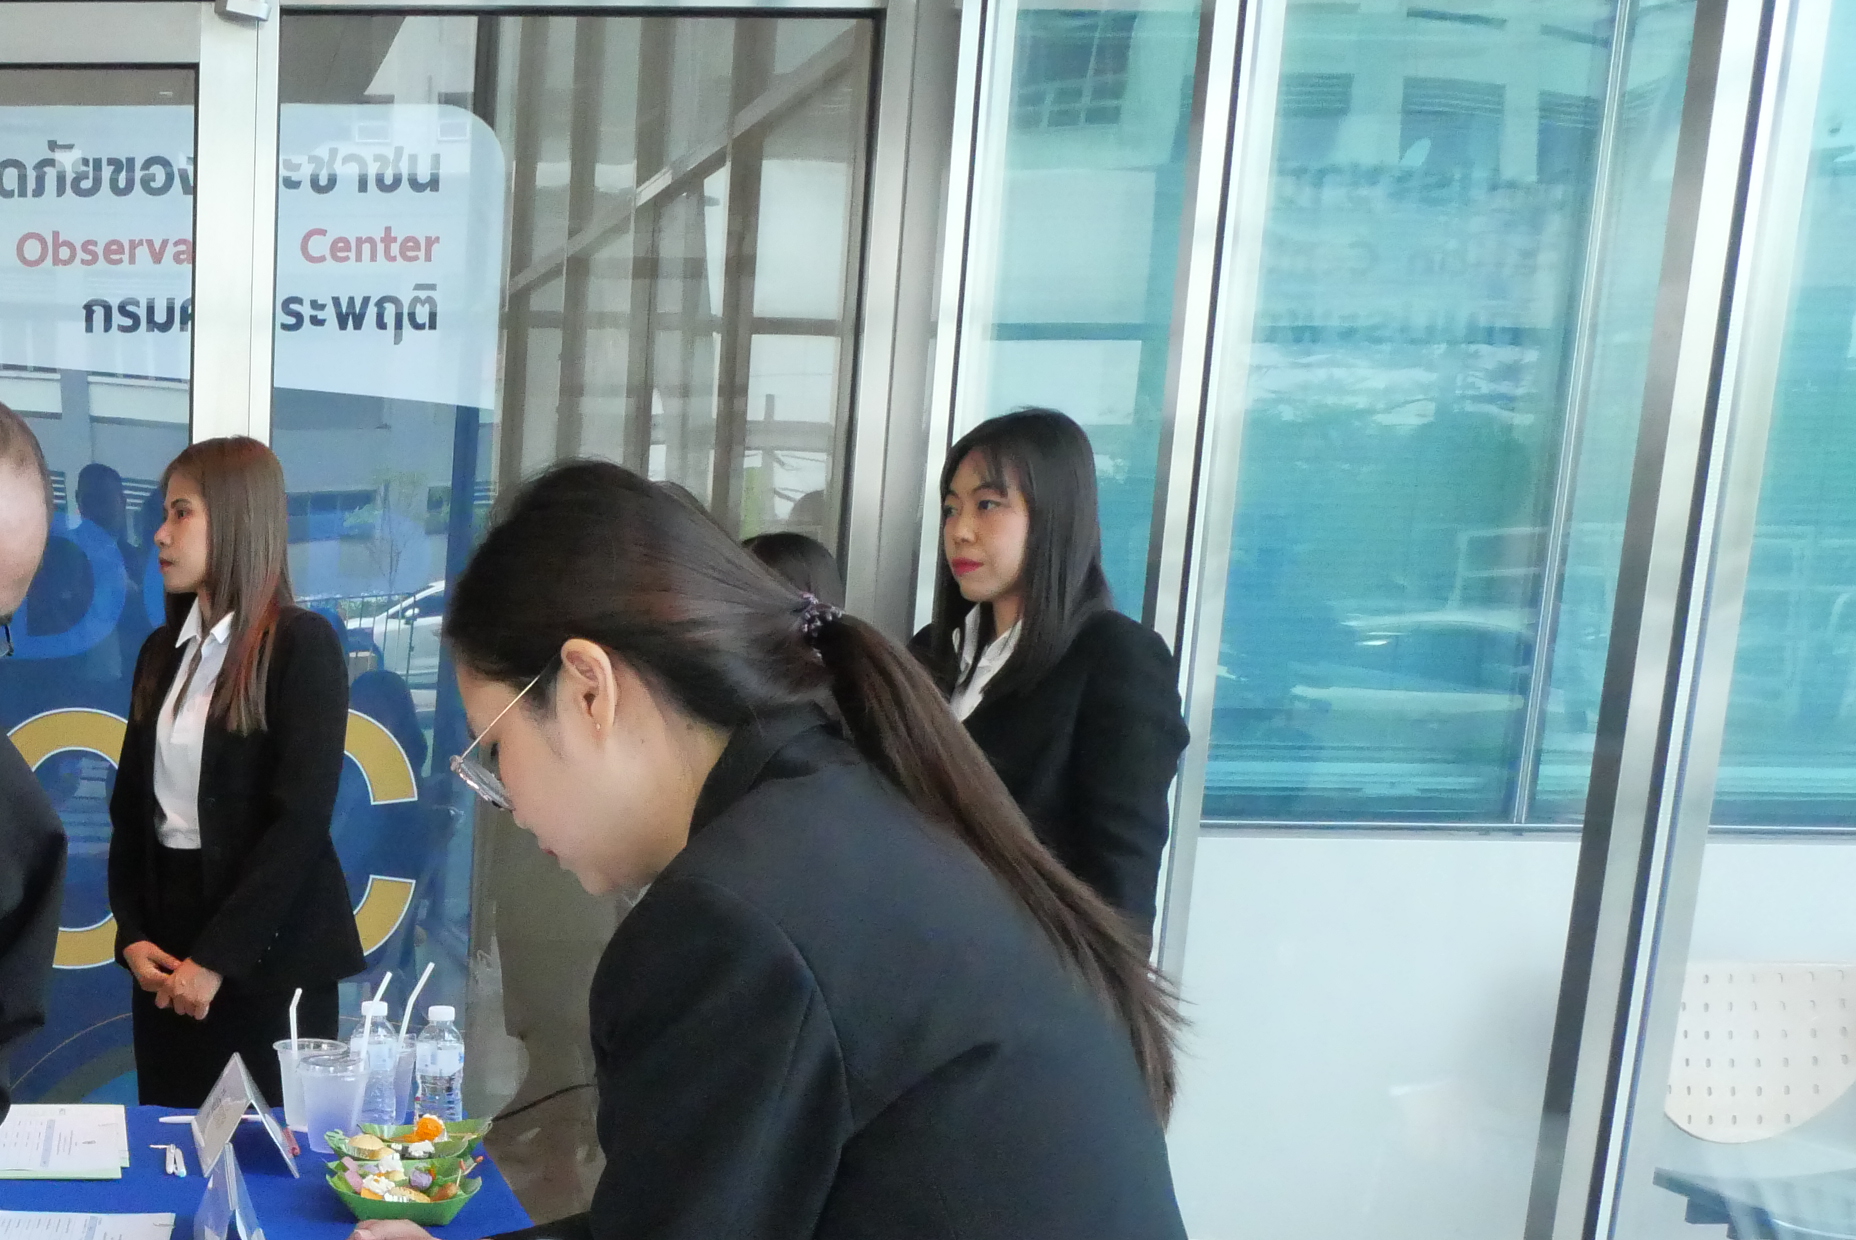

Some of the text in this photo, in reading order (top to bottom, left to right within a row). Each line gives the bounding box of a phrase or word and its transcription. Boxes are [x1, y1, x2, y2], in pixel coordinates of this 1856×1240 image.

[281, 146, 441, 195] ะชาชน
[15, 230, 195, 268] Observa
[300, 225, 441, 265] Center
[279, 283, 438, 346] ระพฤติ
